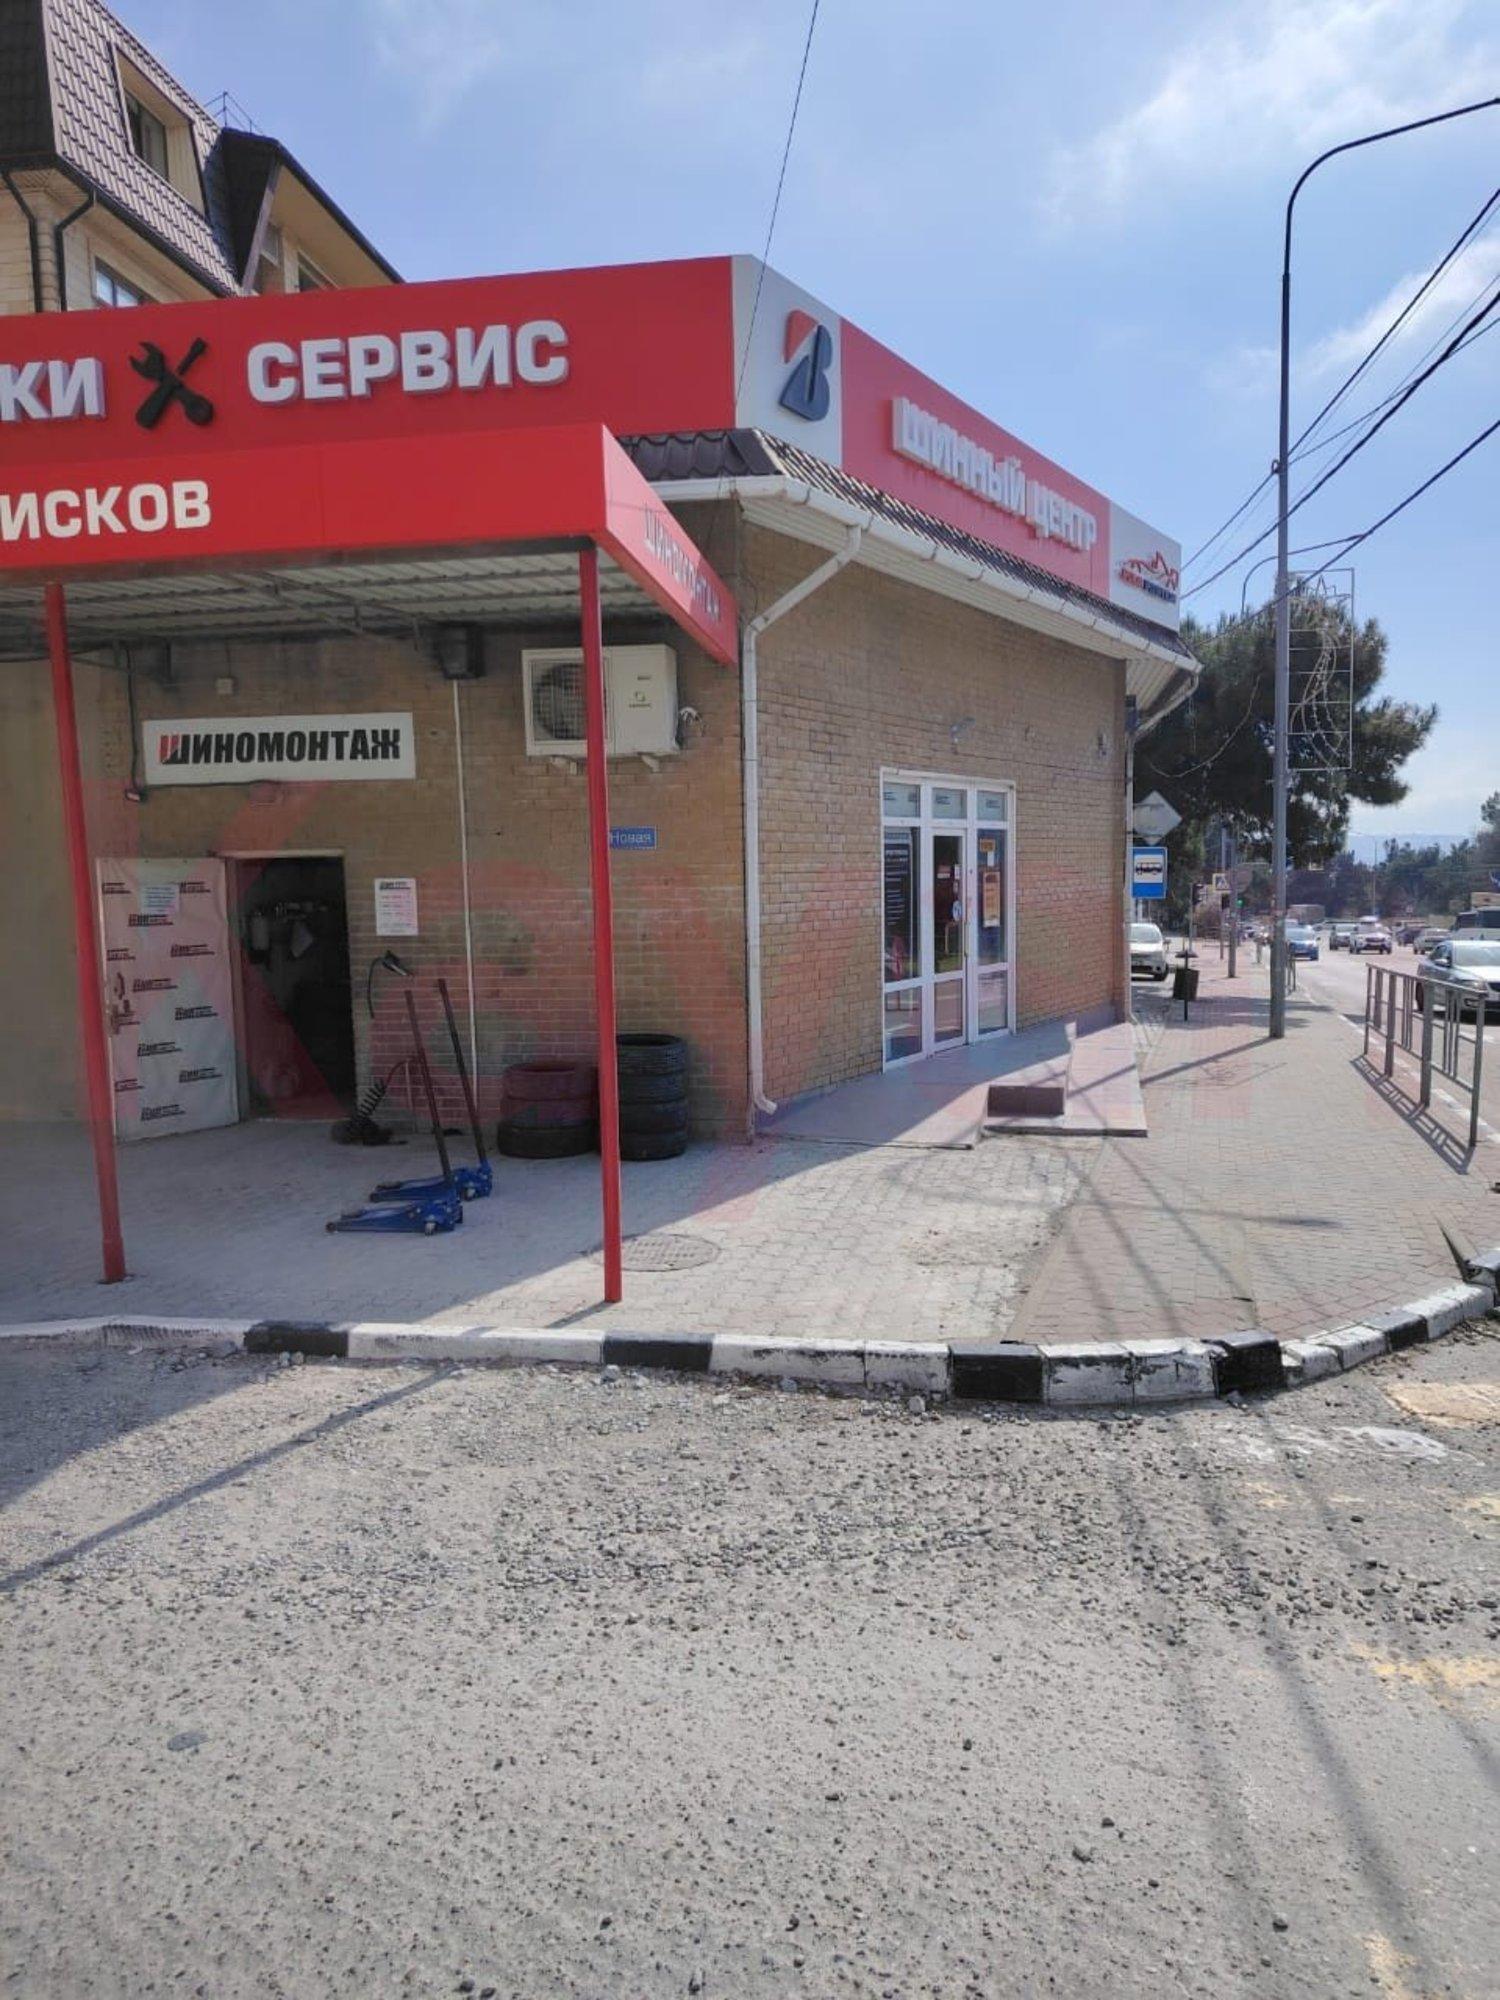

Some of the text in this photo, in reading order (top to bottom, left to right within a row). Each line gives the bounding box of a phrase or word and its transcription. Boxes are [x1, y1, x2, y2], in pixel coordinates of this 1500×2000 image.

[247, 319, 568, 404] СЕРВИС
[893, 397, 1098, 550] ШИННЫЙ ЦЕНТР
[160, 728, 401, 764] ШИНОМОНТАЖ
